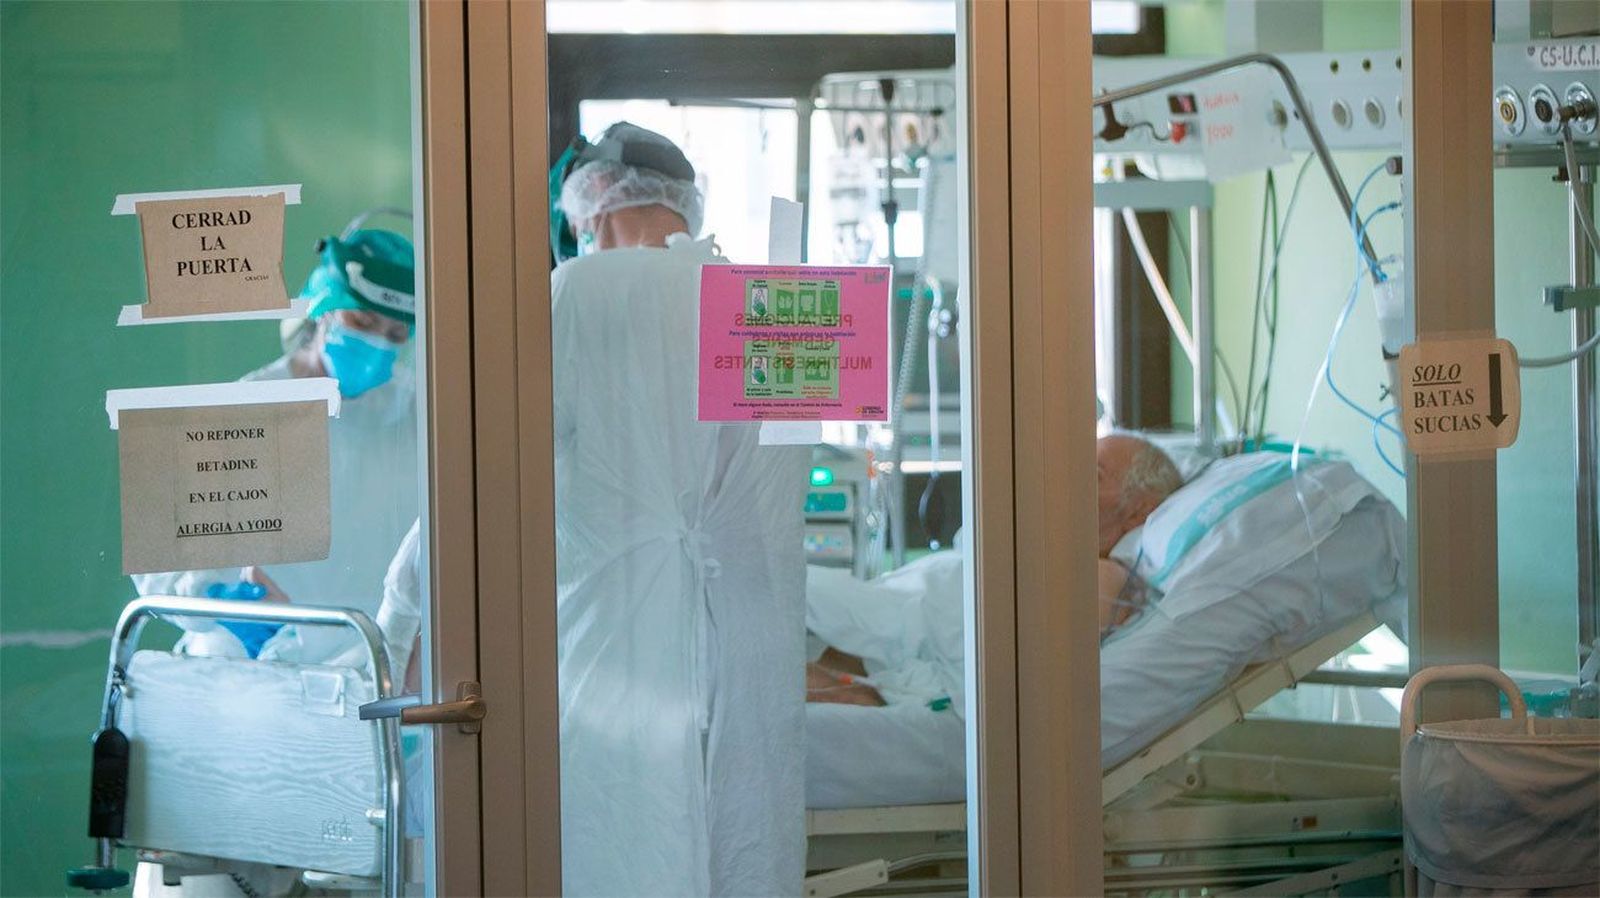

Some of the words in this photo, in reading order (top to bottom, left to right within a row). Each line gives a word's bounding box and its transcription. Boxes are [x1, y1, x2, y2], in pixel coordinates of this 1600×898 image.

[171, 209, 251, 230] CERRAD
[200, 236, 226, 251] LA
[177, 258, 252, 277] PUERTA
[1412, 363, 1461, 383] SOLO
[1414, 388, 1474, 408] BATAS
[1414, 414, 1482, 434] SUCIAS
[186, 431, 204, 442] NO
[207, 428, 265, 441] REPONER
[197, 459, 258, 472] BETADINE
[189, 492, 206, 504] EN
[209, 491, 225, 502] EL
[227, 489, 269, 501] CAJON
[176, 522, 233, 536] ALERGIA
[235, 521, 245, 532] A
[247, 518, 282, 531] YODO
